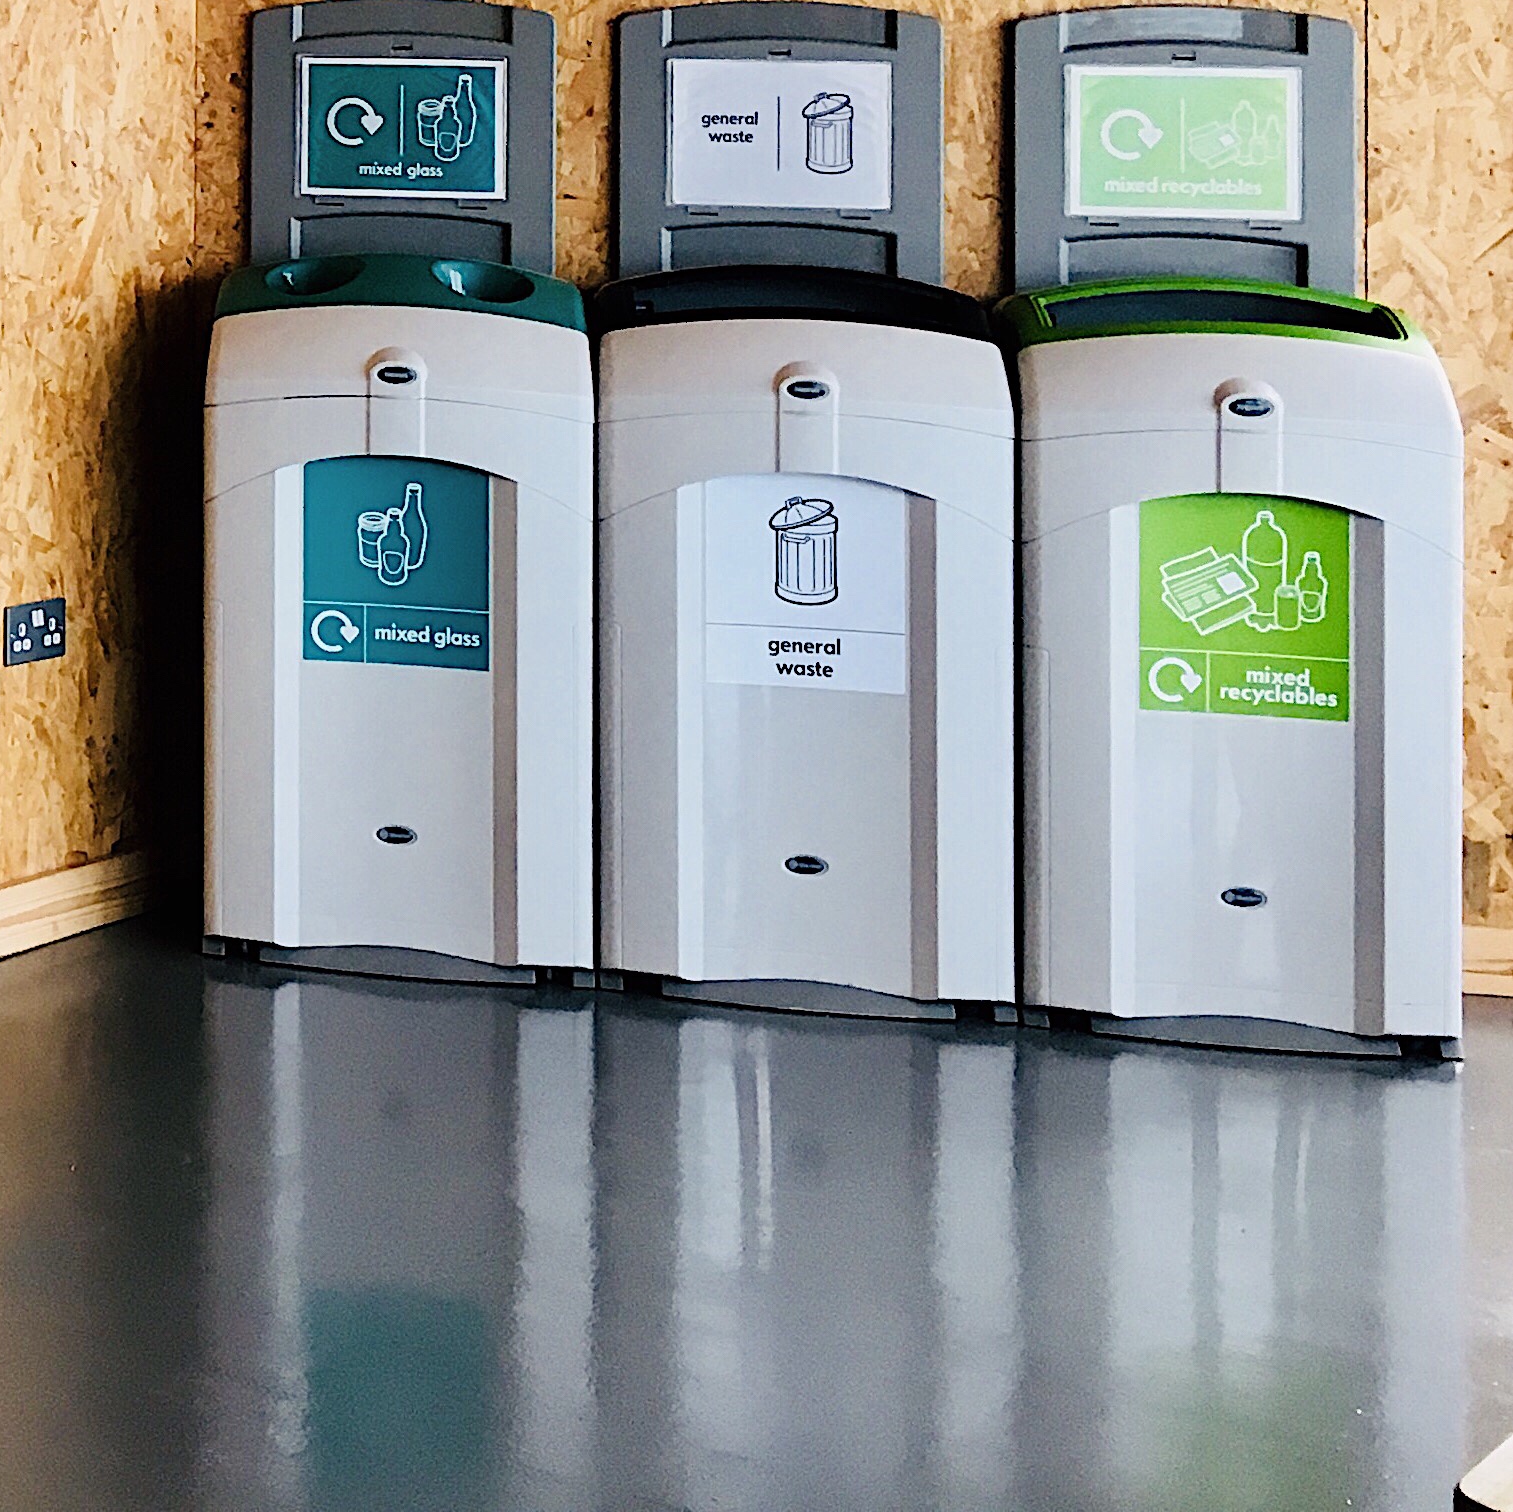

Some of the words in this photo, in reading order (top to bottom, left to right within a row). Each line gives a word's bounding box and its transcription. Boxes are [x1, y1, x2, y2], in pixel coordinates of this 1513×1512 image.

[701, 110, 759, 128] general
[708, 130, 754, 144] waste
[358, 161, 403, 177] mixed
[407, 162, 444, 180] glass
[1104, 176, 1158, 194] mixed
[1161, 178, 1263, 198] recyclables
[374, 622, 430, 644] mixed
[434, 626, 480, 649] glass
[768, 638, 841, 657] general
[775, 662, 834, 678] waste
[1245, 665, 1310, 687] mixed
[1219, 684, 1338, 707] recyclables
